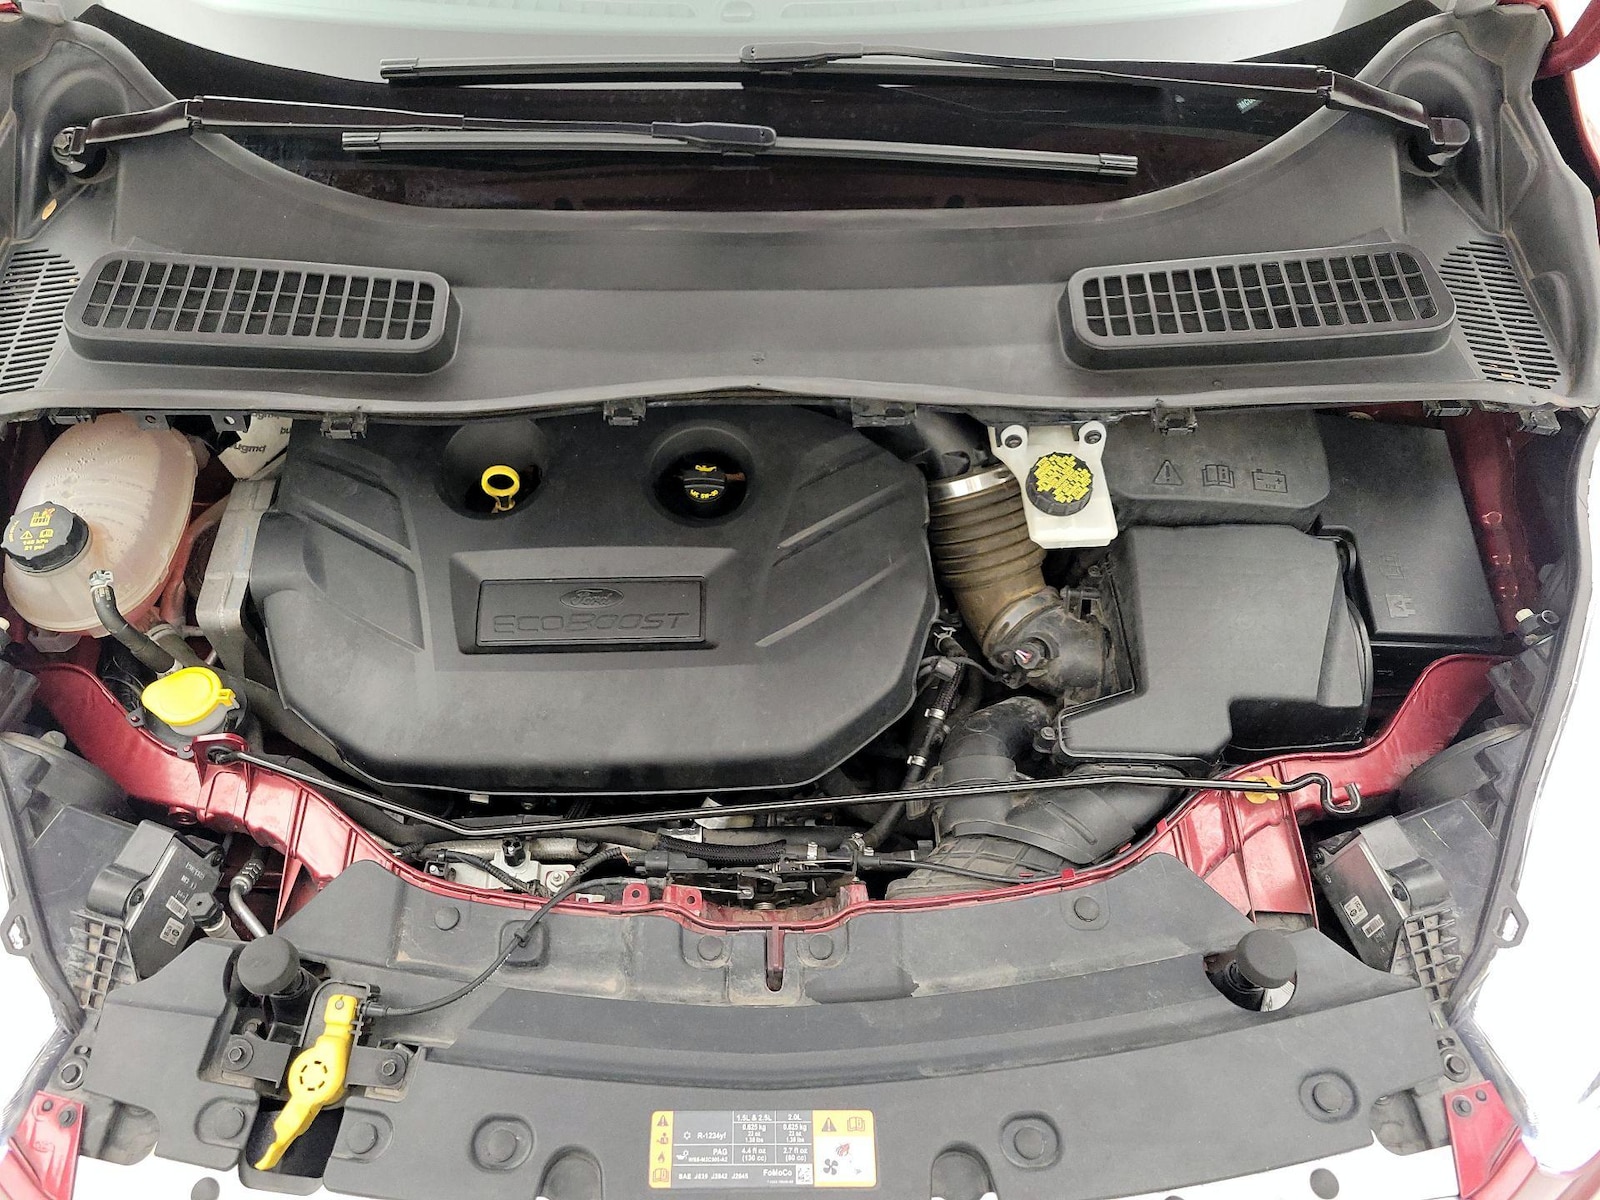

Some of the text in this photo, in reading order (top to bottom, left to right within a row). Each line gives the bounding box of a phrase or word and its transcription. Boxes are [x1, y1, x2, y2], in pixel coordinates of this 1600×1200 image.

[759, 1123, 767, 1132] kg
[799, 1123, 807, 1132] kg
[757, 1154, 767, 1162] cc)
[796, 1154, 807, 1162] cc)
[763, 1168, 793, 1177] FoMoCo
